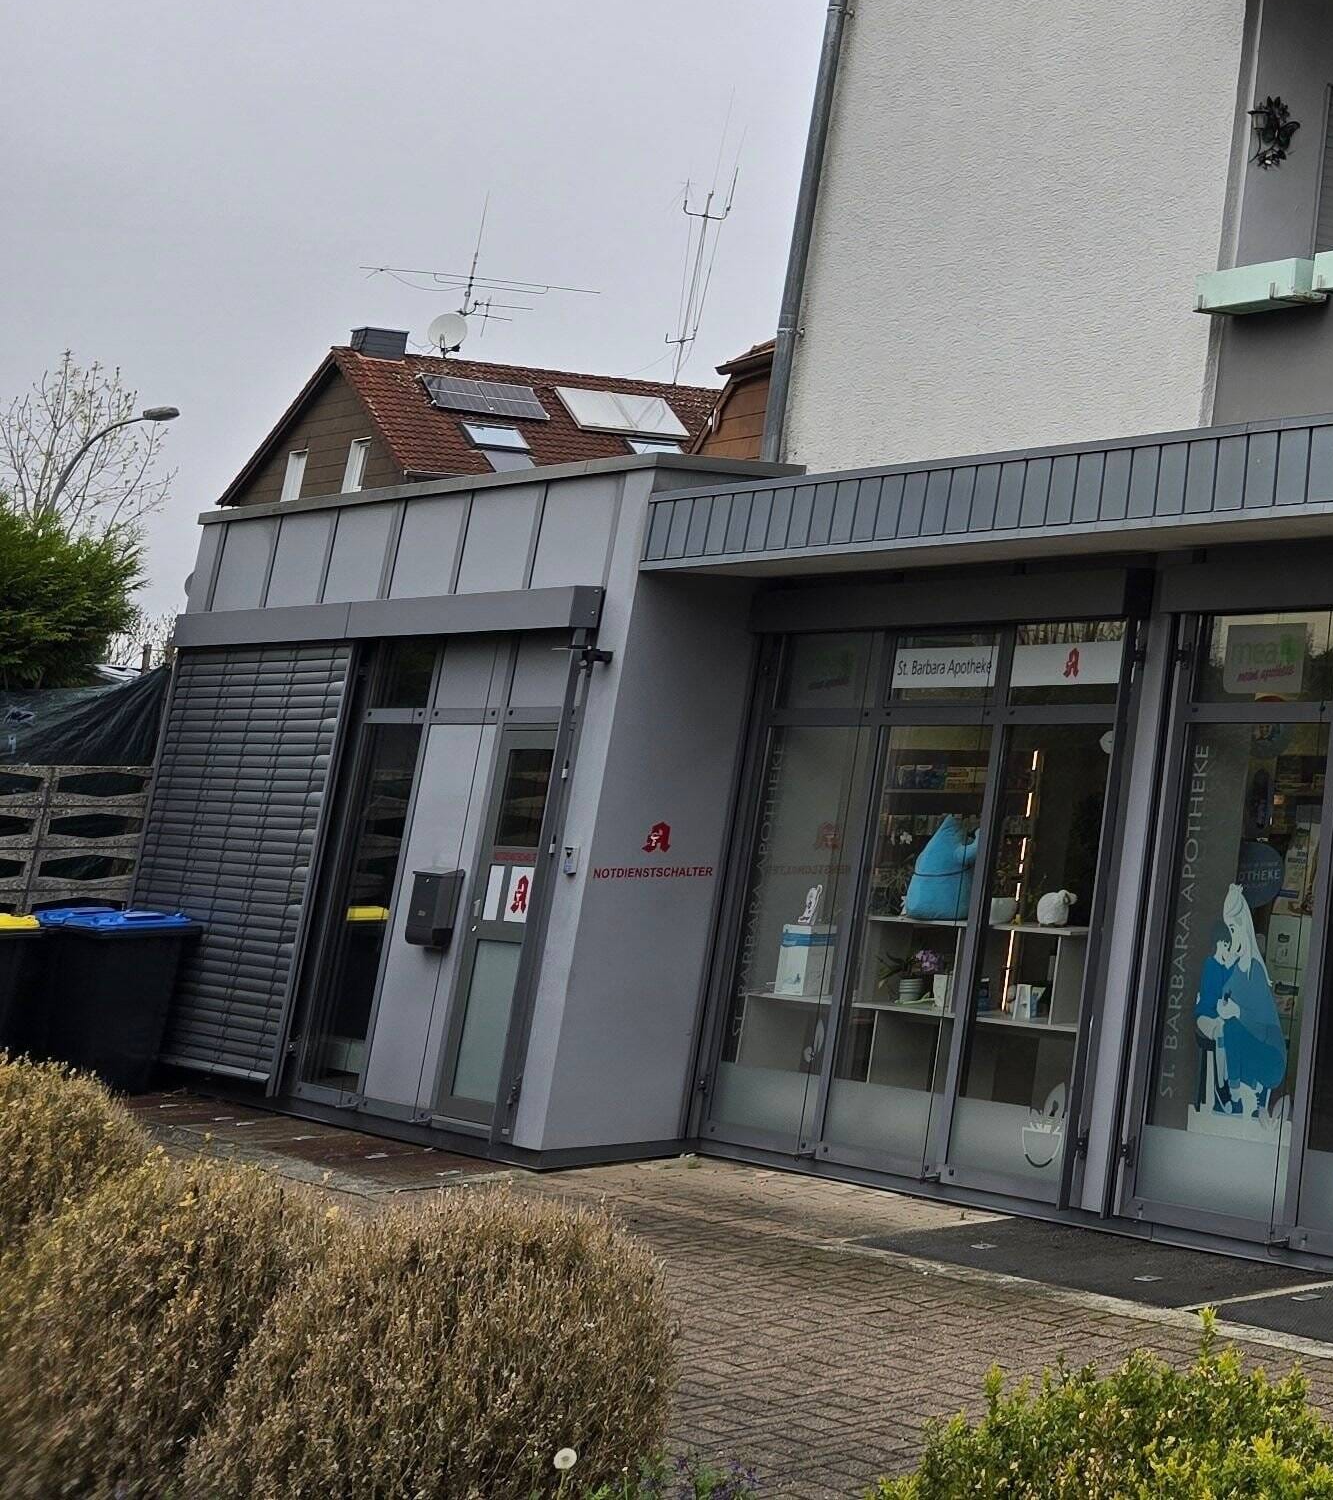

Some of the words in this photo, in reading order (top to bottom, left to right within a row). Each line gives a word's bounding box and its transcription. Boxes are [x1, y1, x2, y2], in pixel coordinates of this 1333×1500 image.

[896, 660, 909, 676] St.
[911, 659, 946, 676] Barbara
[947, 658, 993, 679] Apotheke
[1181, 744, 1209, 902] APOTHEKE
[593, 866, 712, 879] NOTDIENSTSCHALTER
[737, 882, 762, 998] BARBARA
[756, 743, 785, 877] APOTHEKE
[1164, 910, 1191, 1051] BARBARA
[1160, 1062, 1175, 1099] ST.
